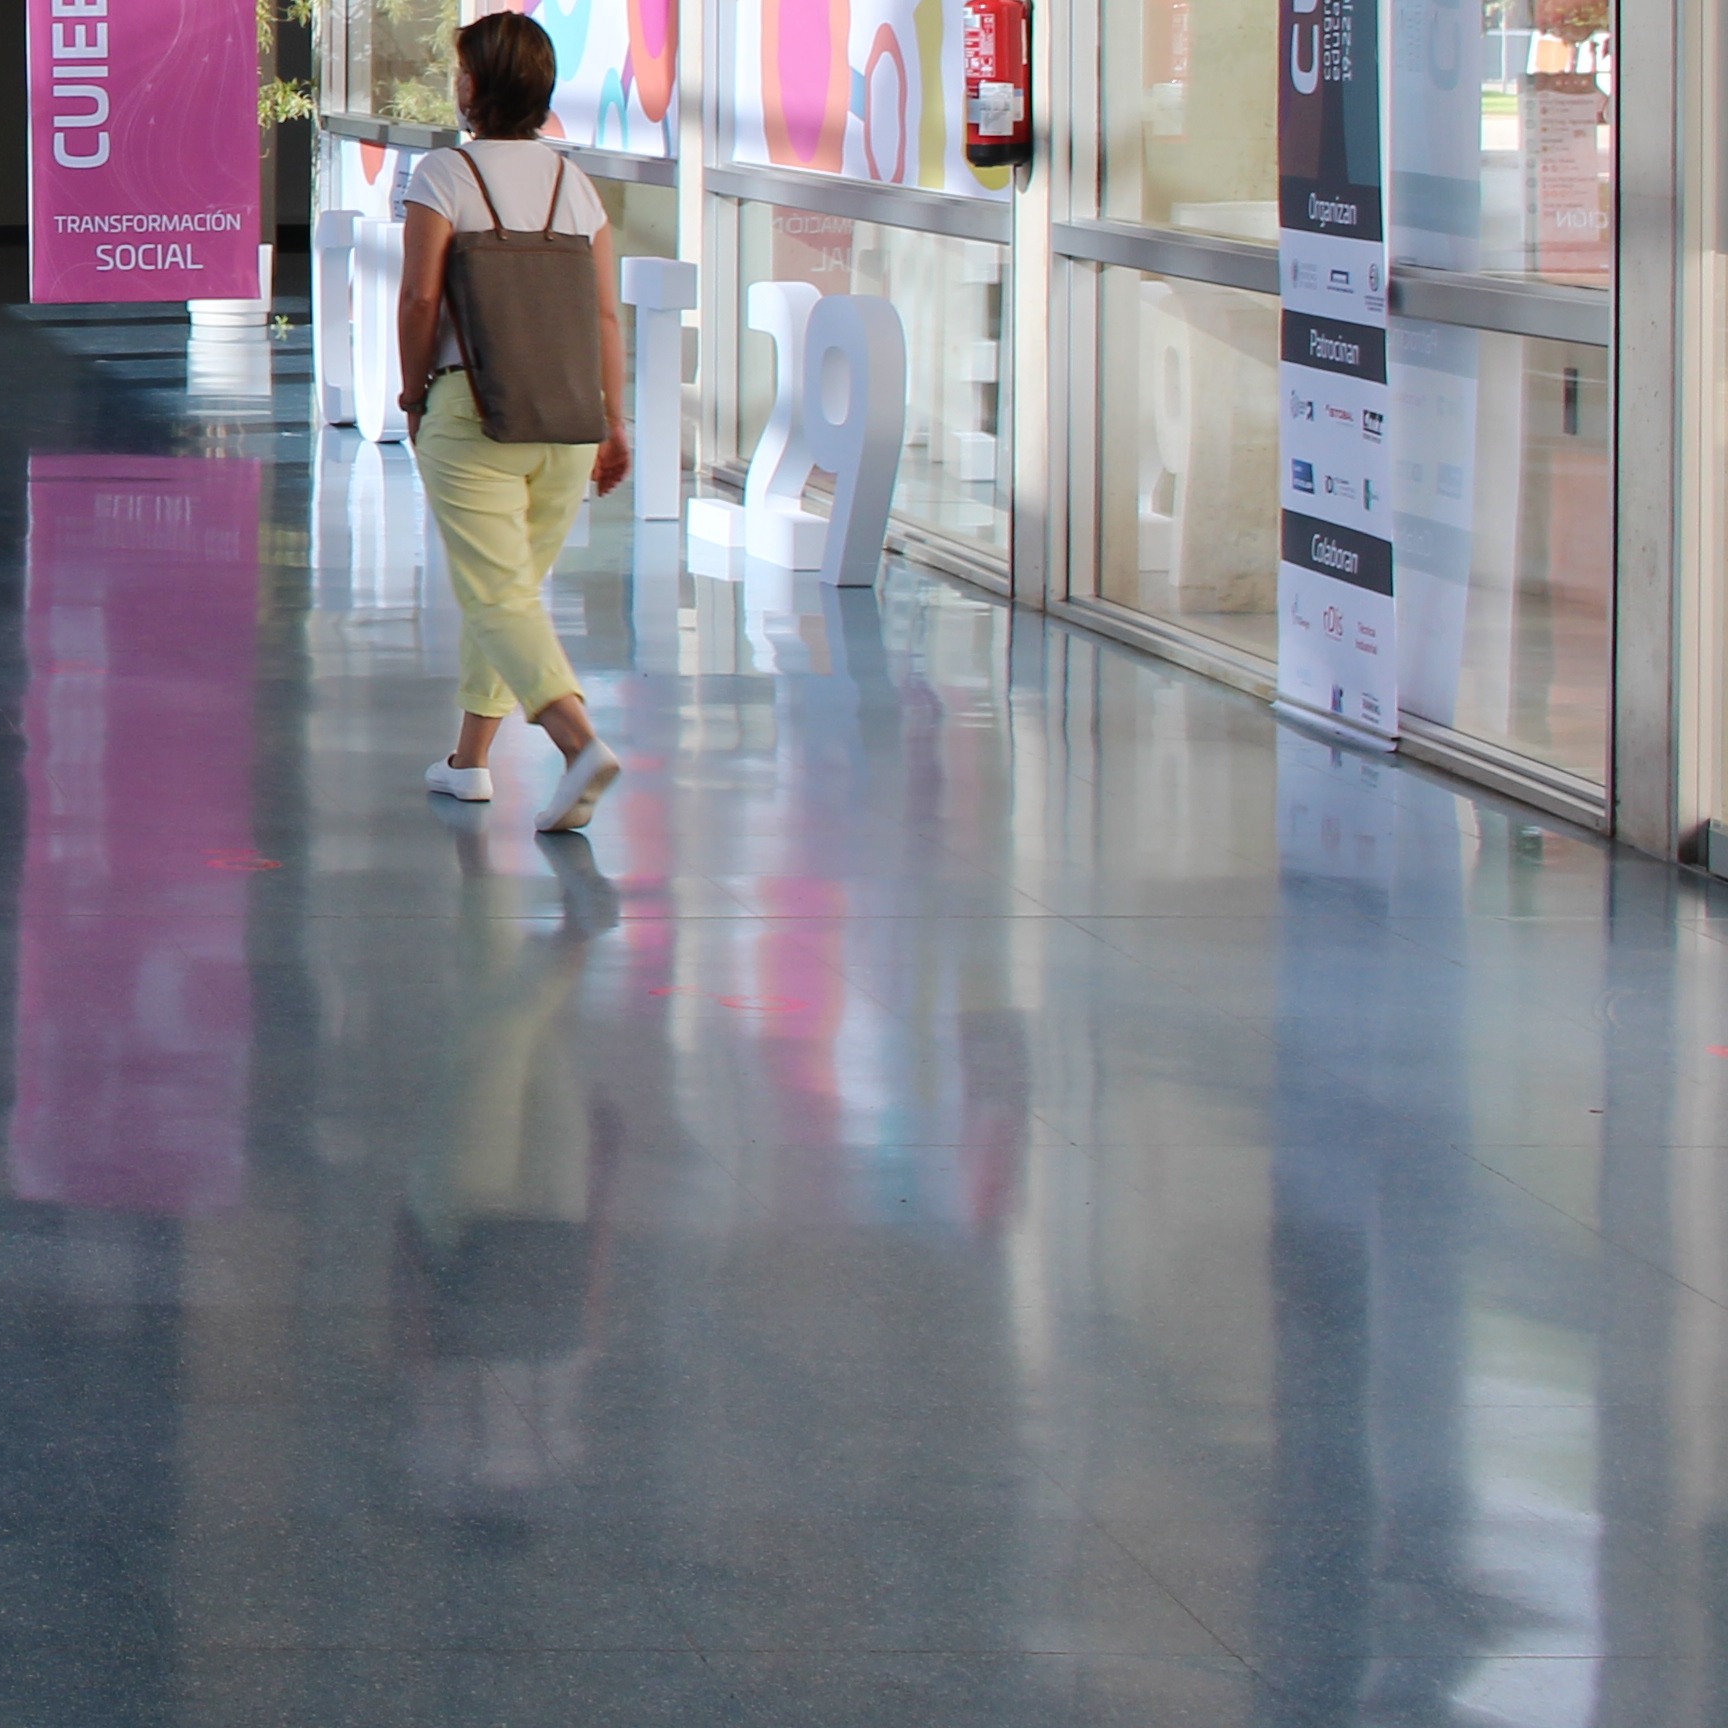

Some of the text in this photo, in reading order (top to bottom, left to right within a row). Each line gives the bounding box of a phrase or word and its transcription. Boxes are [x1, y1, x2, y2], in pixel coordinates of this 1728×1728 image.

[53, 210, 242, 234] TRANSFORMACIÓN
[1308, 192, 1357, 228] Organizan
[95, 243, 204, 272] SOCIAL
[1309, 328, 1360, 366] Patrocinan
[1311, 533, 1359, 574] Colaboran
